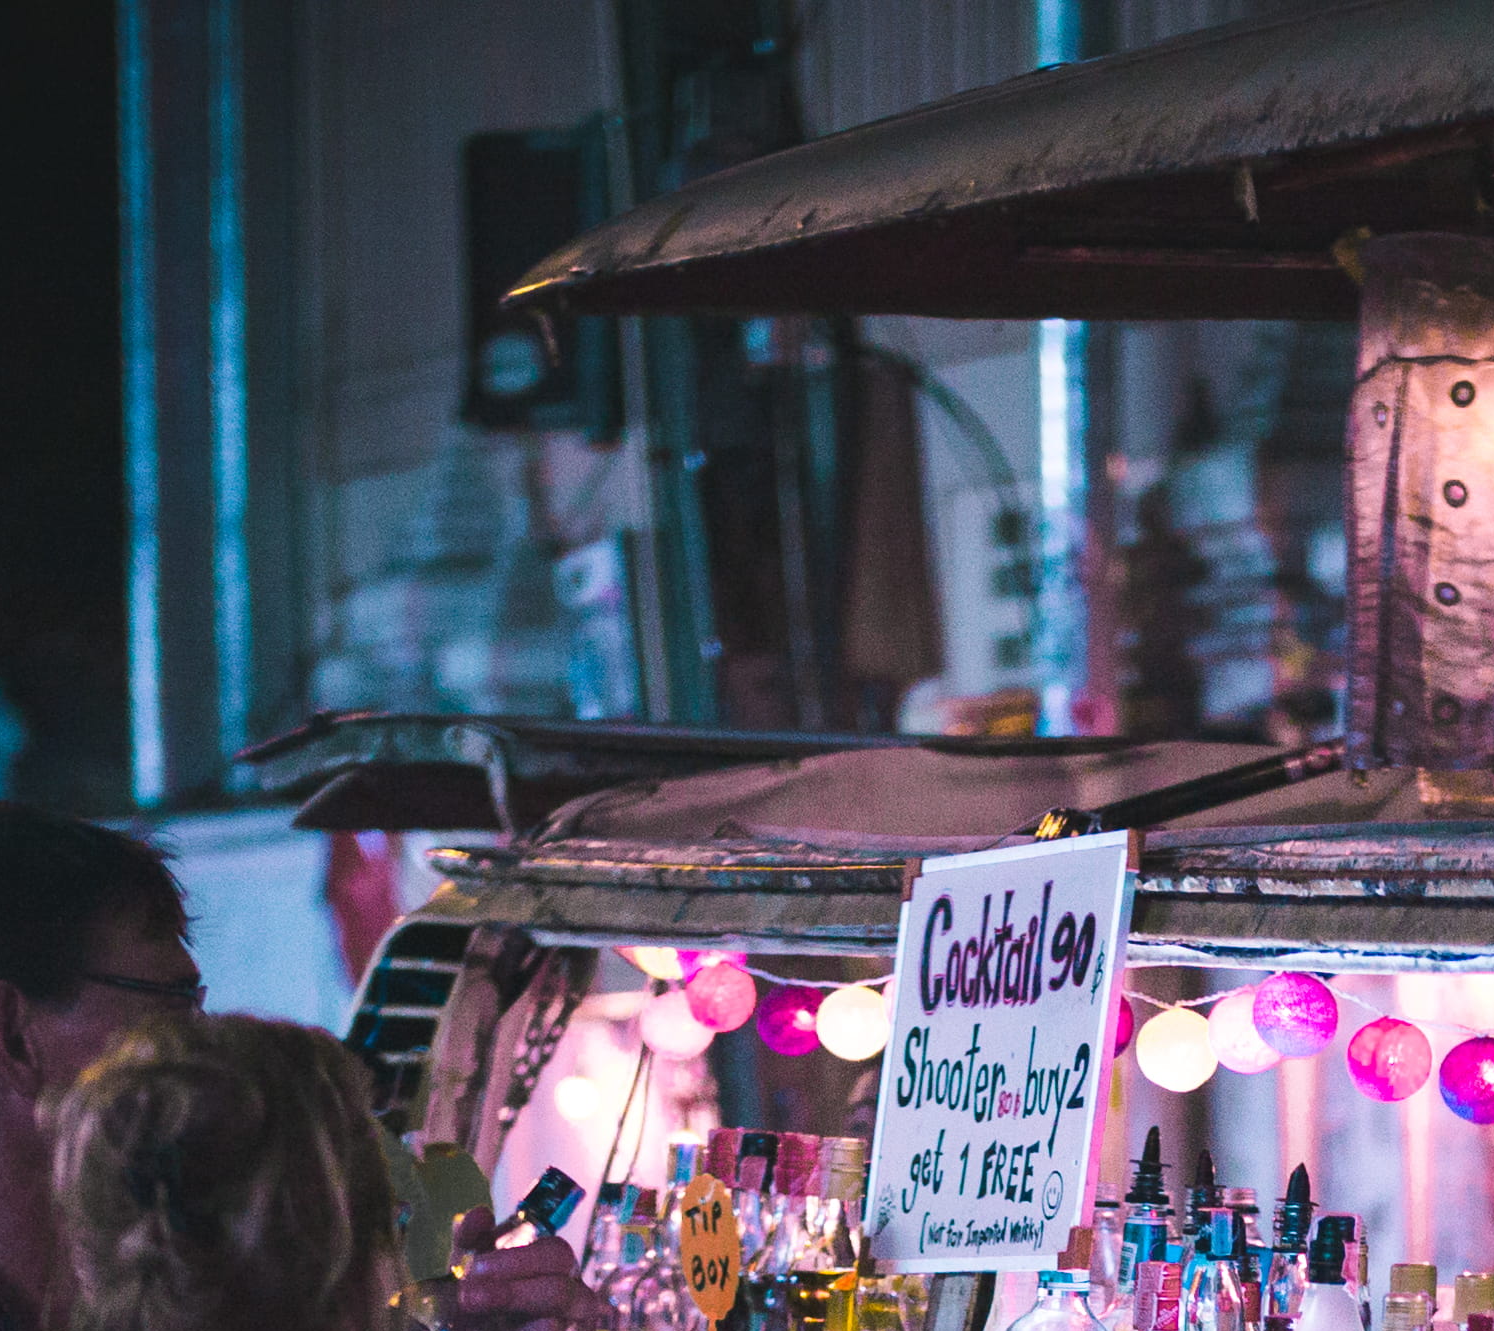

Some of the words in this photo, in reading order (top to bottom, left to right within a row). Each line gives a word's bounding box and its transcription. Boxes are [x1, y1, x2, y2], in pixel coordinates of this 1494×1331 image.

[919, 880, 1053, 1015] Cocktail
[1048, 911, 1096, 992] 90
[896, 1023, 1006, 1124] Shooter
[1022, 1026, 1071, 1157] buy
[1066, 1042, 1091, 1110] 2
[902, 1129, 946, 1213] get
[958, 1142, 970, 1196] 1
[976, 1138, 1041, 1203] FREE
